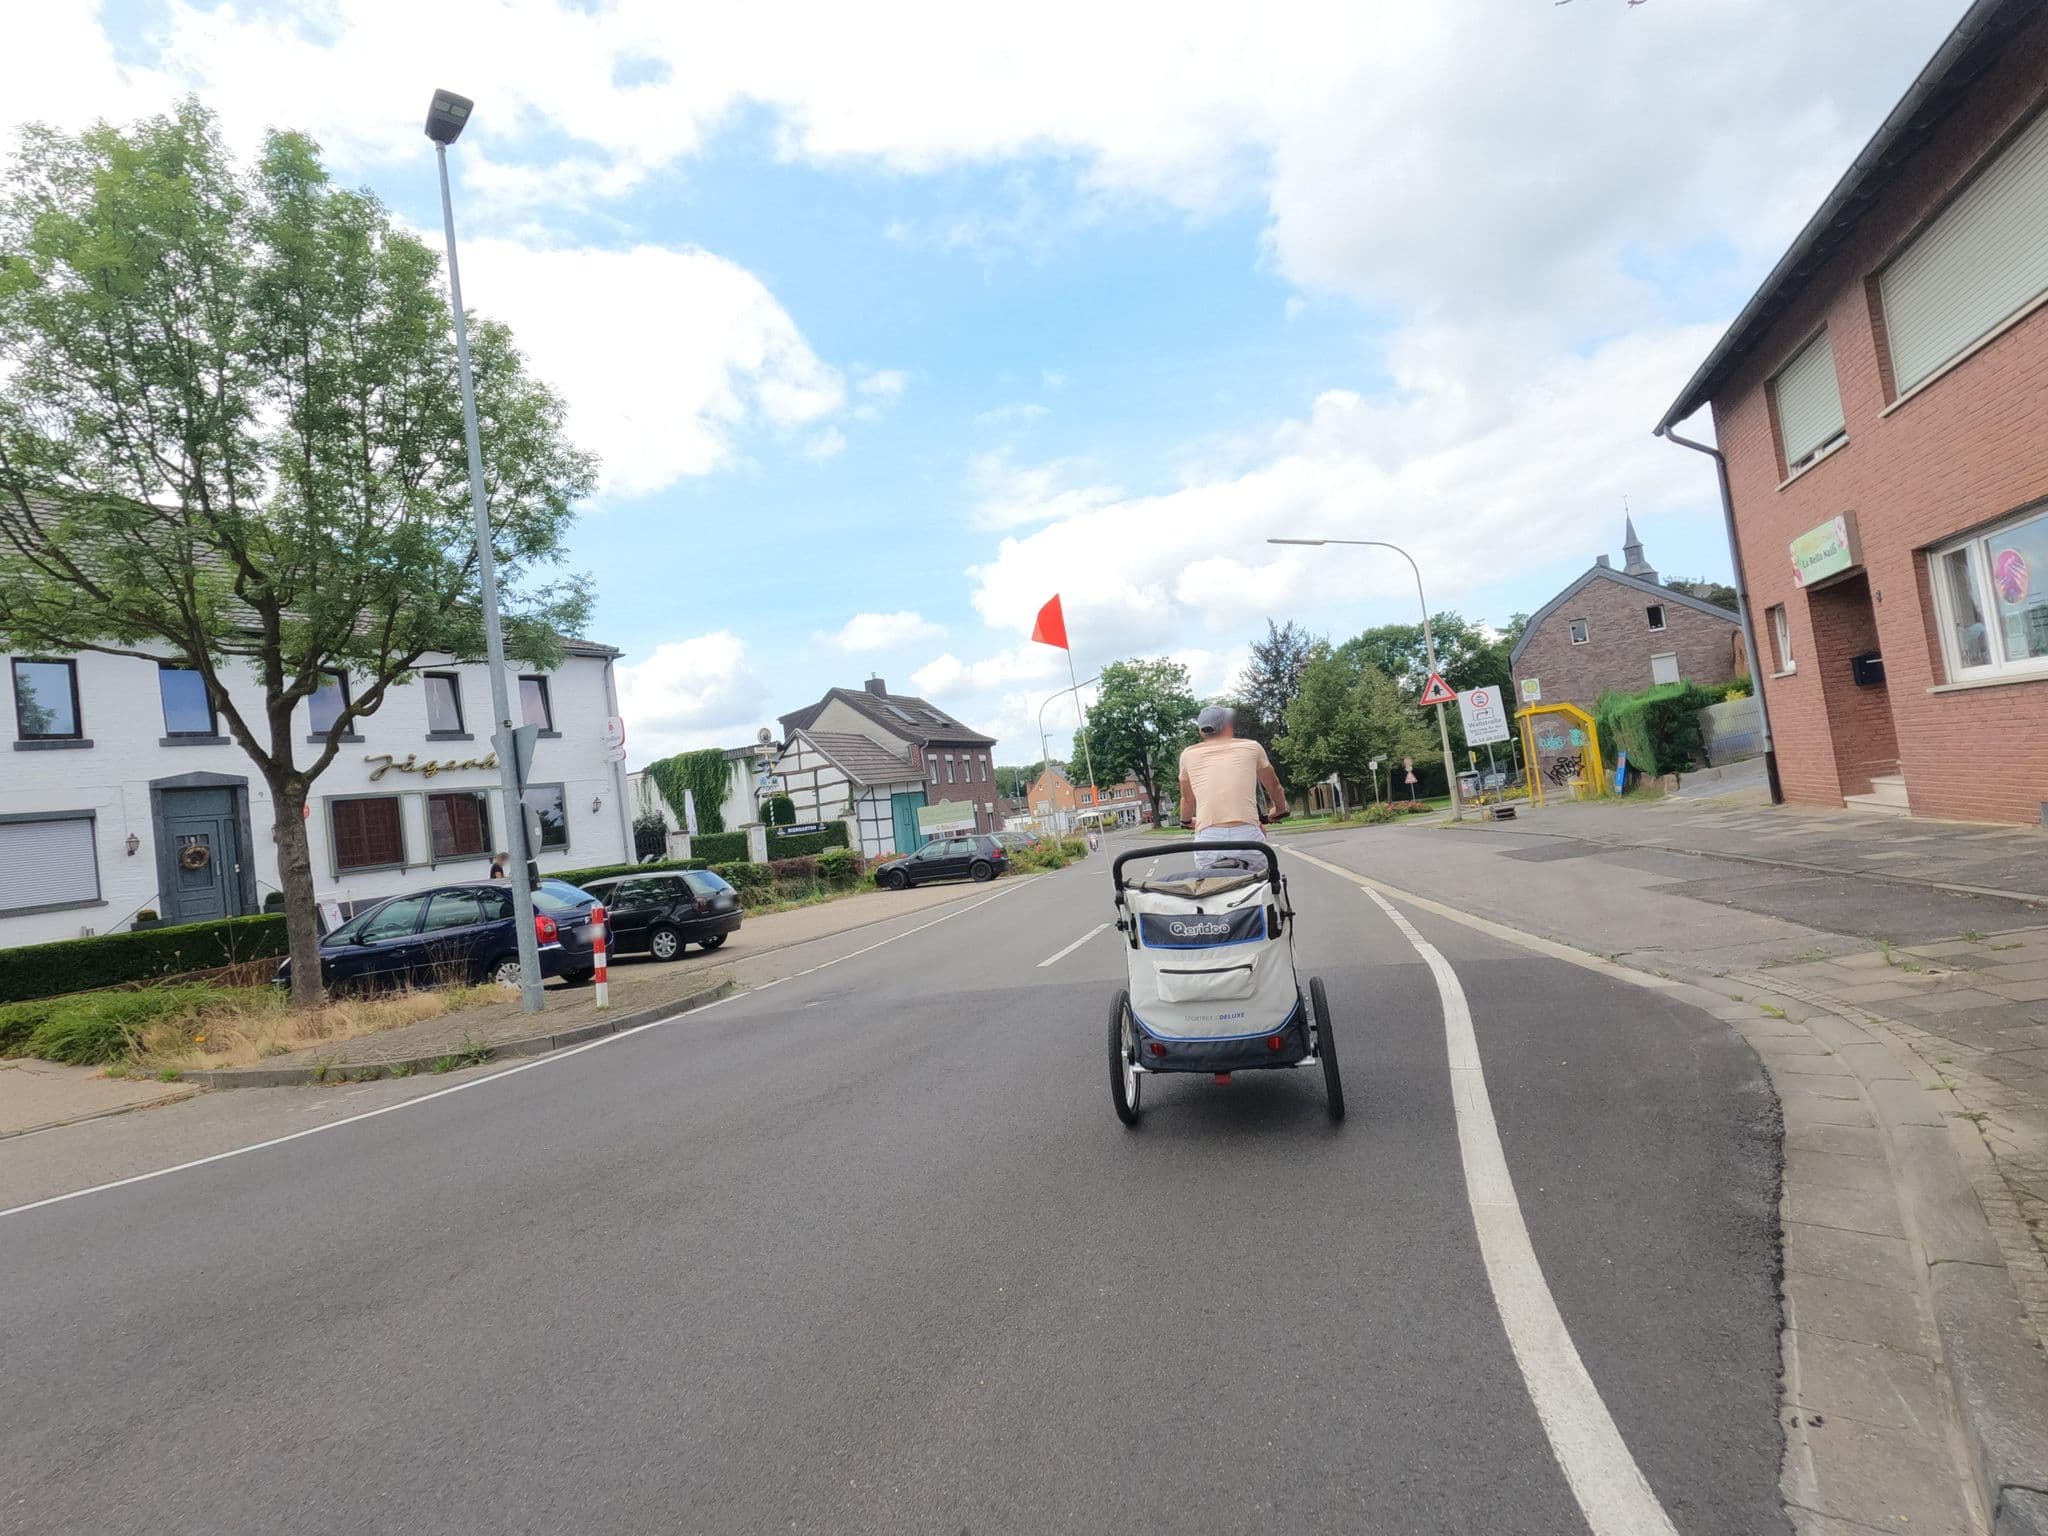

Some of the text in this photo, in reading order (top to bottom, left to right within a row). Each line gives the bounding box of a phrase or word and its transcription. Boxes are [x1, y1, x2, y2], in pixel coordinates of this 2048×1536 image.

[364, 752, 500, 781] Jägerh
[1170, 921, 1230, 936] Qeridoo
[1218, 1011, 1245, 1021] DELUXE
